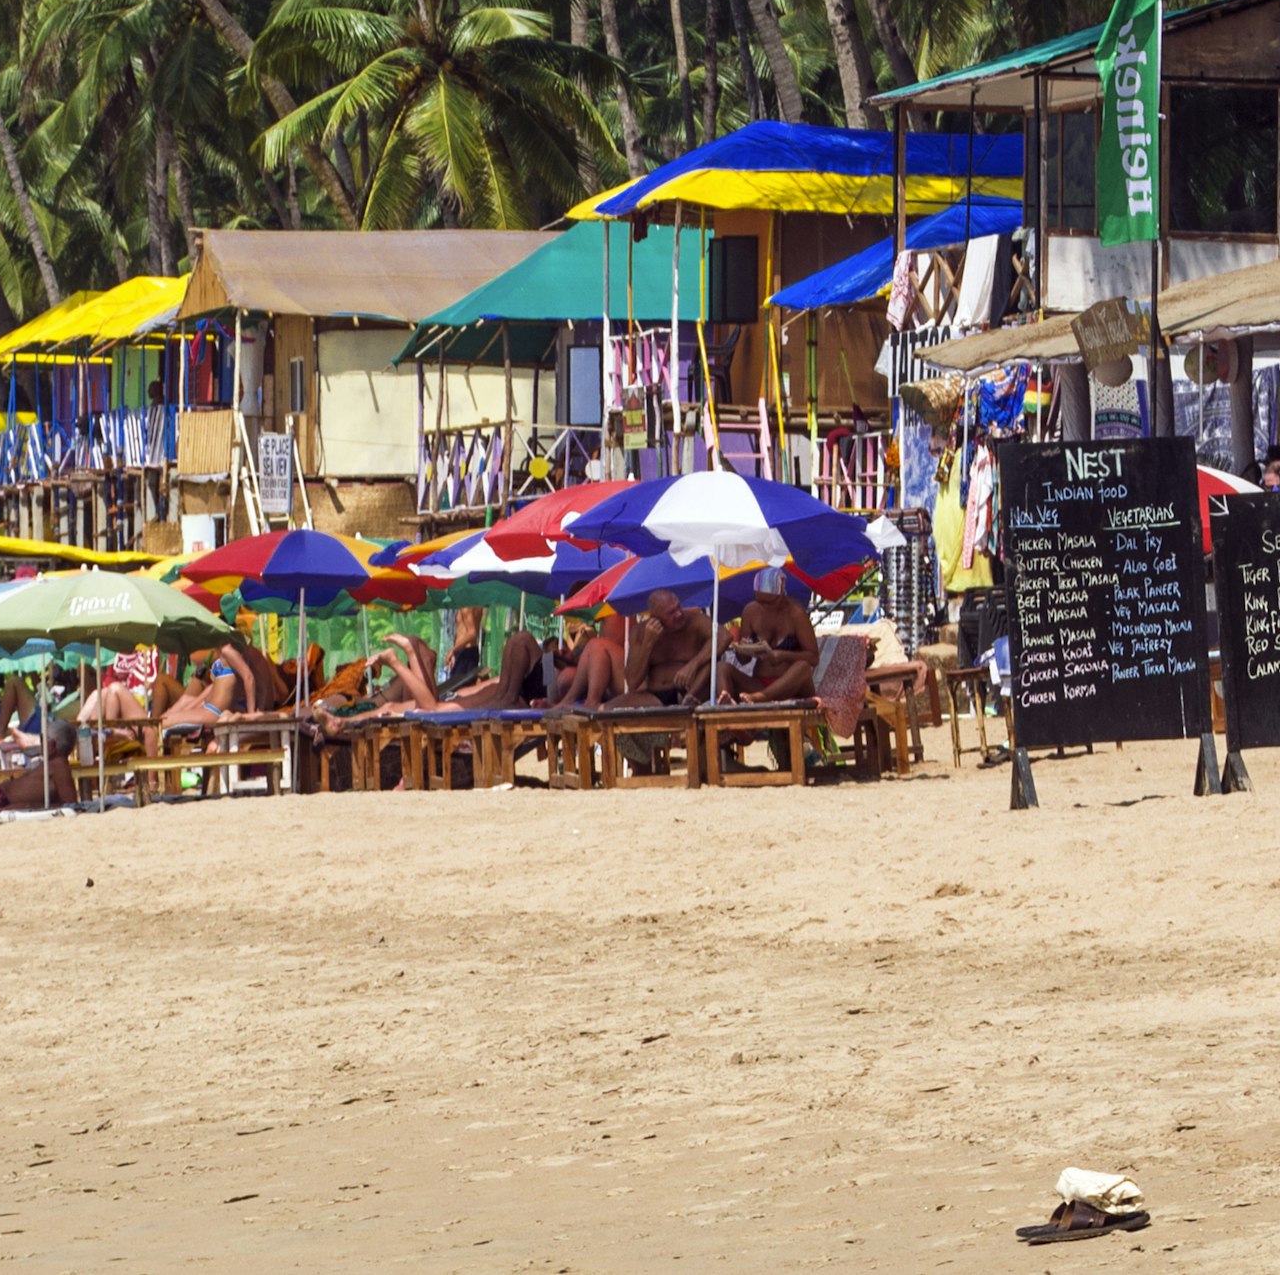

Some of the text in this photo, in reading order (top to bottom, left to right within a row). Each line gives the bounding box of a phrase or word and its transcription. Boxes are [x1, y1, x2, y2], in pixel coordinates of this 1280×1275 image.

[1064, 447, 1126, 482] NEST
[1042, 481, 1094, 502] INDIAN
[1009, 505, 1059, 528] NON VEG
[1107, 502, 1175, 528] VEGETARIANS
[1011, 532, 1096, 552] CHICKEN MASALA
[1116, 532, 1138, 552] DAL
[1013, 553, 1103, 573] BUTTER CHICKEN
[1123, 558, 1148, 574] ALOO
[1014, 571, 1119, 592] CHICKEN TIKKA MASALA
[1238, 563, 1271, 585] TIGER
[1048, 590, 1088, 605] MASALA
[1113, 576, 1181, 602] PALAK PANEER
[1113, 600, 1180, 620] VEG MASALA
[1244, 591, 1268, 613] KING
[1047, 606, 1088, 623] MASALA
[1022, 627, 1096, 649] PRAWNS MASALA
[1112, 621, 1162, 637] MUSHROOM
[1108, 640, 1124, 656] VEG
[1245, 635, 1268, 655] RED
[1020, 650, 1056, 666] CHICKEN
[1021, 667, 1059, 687] CHICKEN
[1112, 662, 1140, 684] PANEER
[1021, 683, 1097, 707] CHICKEN KORMA
